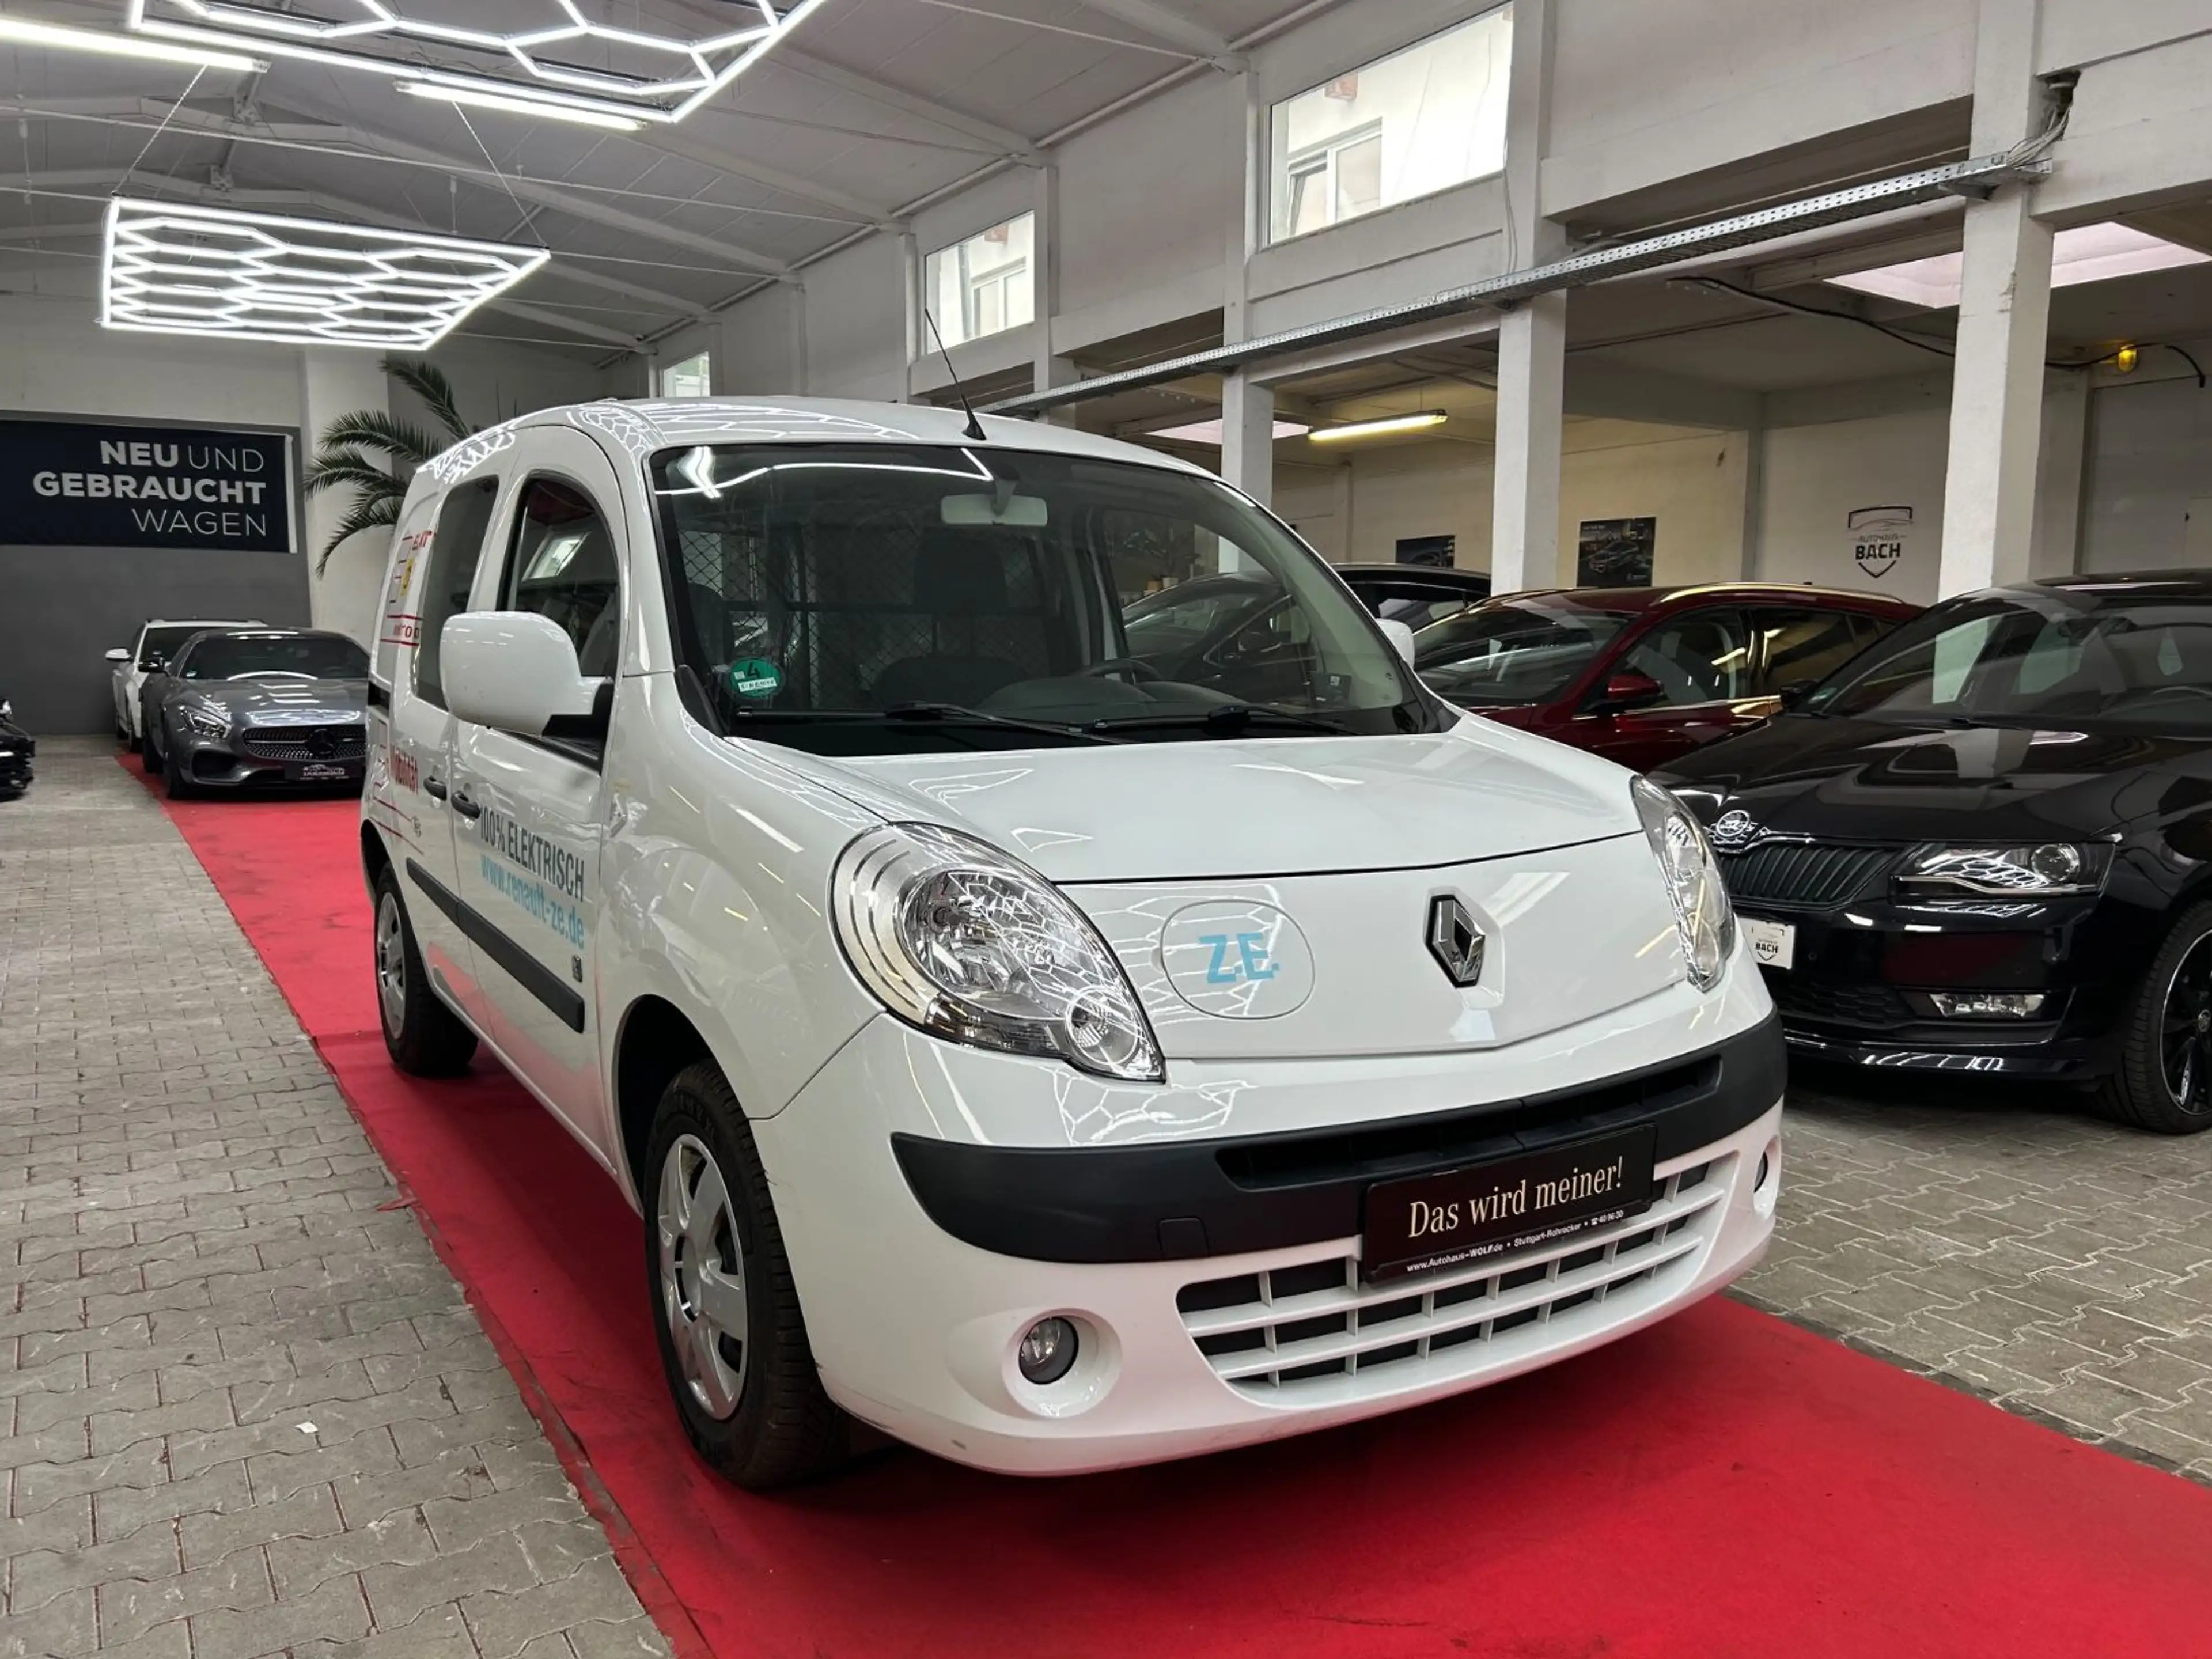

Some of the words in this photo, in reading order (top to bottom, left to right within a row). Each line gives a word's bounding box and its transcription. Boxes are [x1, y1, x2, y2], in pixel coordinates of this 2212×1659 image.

[100, 440, 179, 466] NEU
[188, 445, 264, 472] UND
[33, 471, 266, 504] GEBRAUCHT
[131, 508, 267, 537] WAGEN
[1855, 542, 1900, 560] BACH
[747, 661, 761, 679] 4
[480, 805, 505, 853] 100%
[508, 820, 584, 903] ELEKTRISCH
[480, 853, 584, 950] www.renault-ze.de
[1755, 942, 1778, 953] BACH
[1407, 1200, 1459, 1238] Das
[1469, 1179, 1527, 1226] wird
[1535, 1155, 1623, 1210] meiner!
